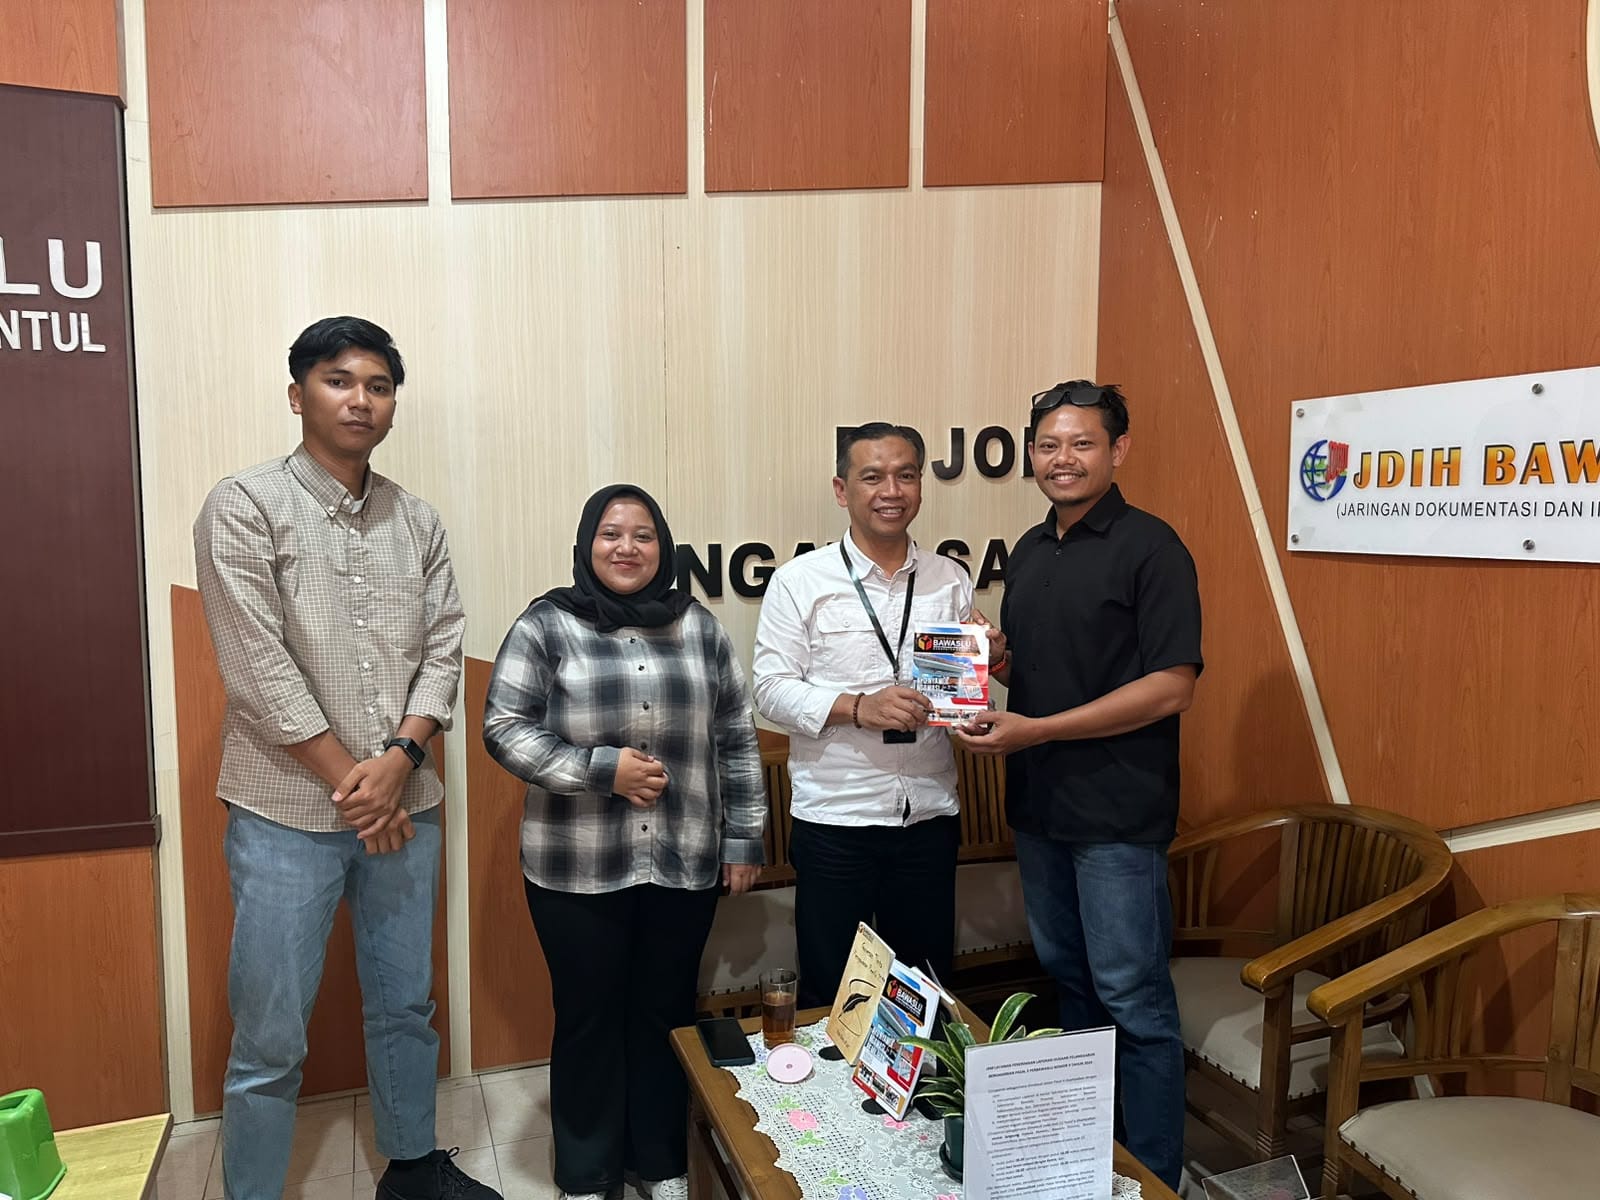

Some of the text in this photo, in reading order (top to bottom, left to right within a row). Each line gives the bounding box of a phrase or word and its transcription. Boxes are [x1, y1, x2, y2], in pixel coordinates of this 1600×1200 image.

[1353, 446, 1462, 489] JDIH
[1336, 502, 1410, 519] (JARINGAN
[1415, 501, 1538, 517] DOKUMENTASI
[1544, 501, 1583, 517] DAN
[933, 640, 971, 648] BAWASLU
